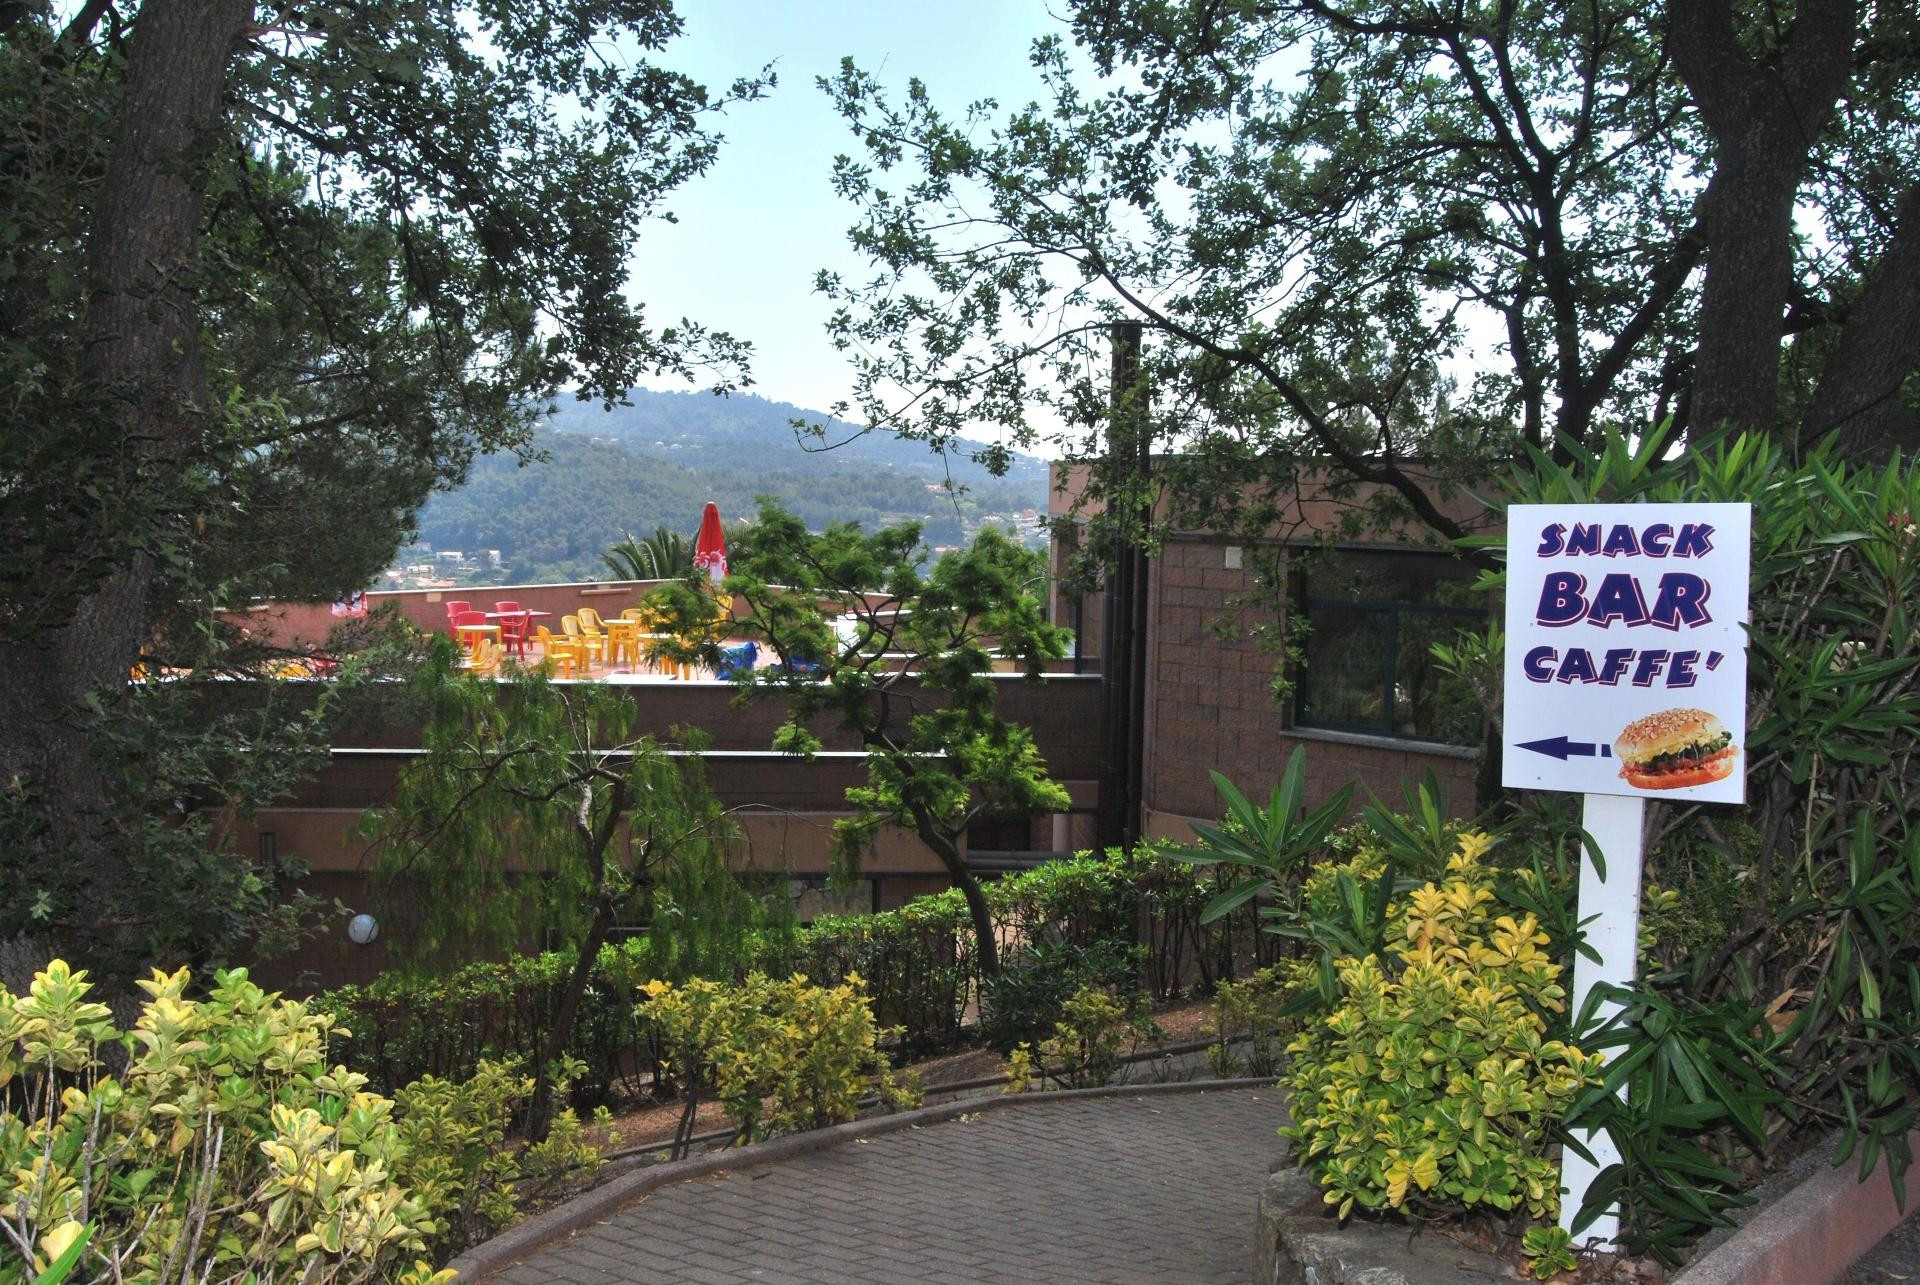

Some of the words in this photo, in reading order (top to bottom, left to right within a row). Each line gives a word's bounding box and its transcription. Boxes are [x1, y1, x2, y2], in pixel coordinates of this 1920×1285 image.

[1537, 522, 1715, 558] SNACK
[1536, 572, 1713, 631] BAR
[1523, 646, 1724, 688] CAFFE'
